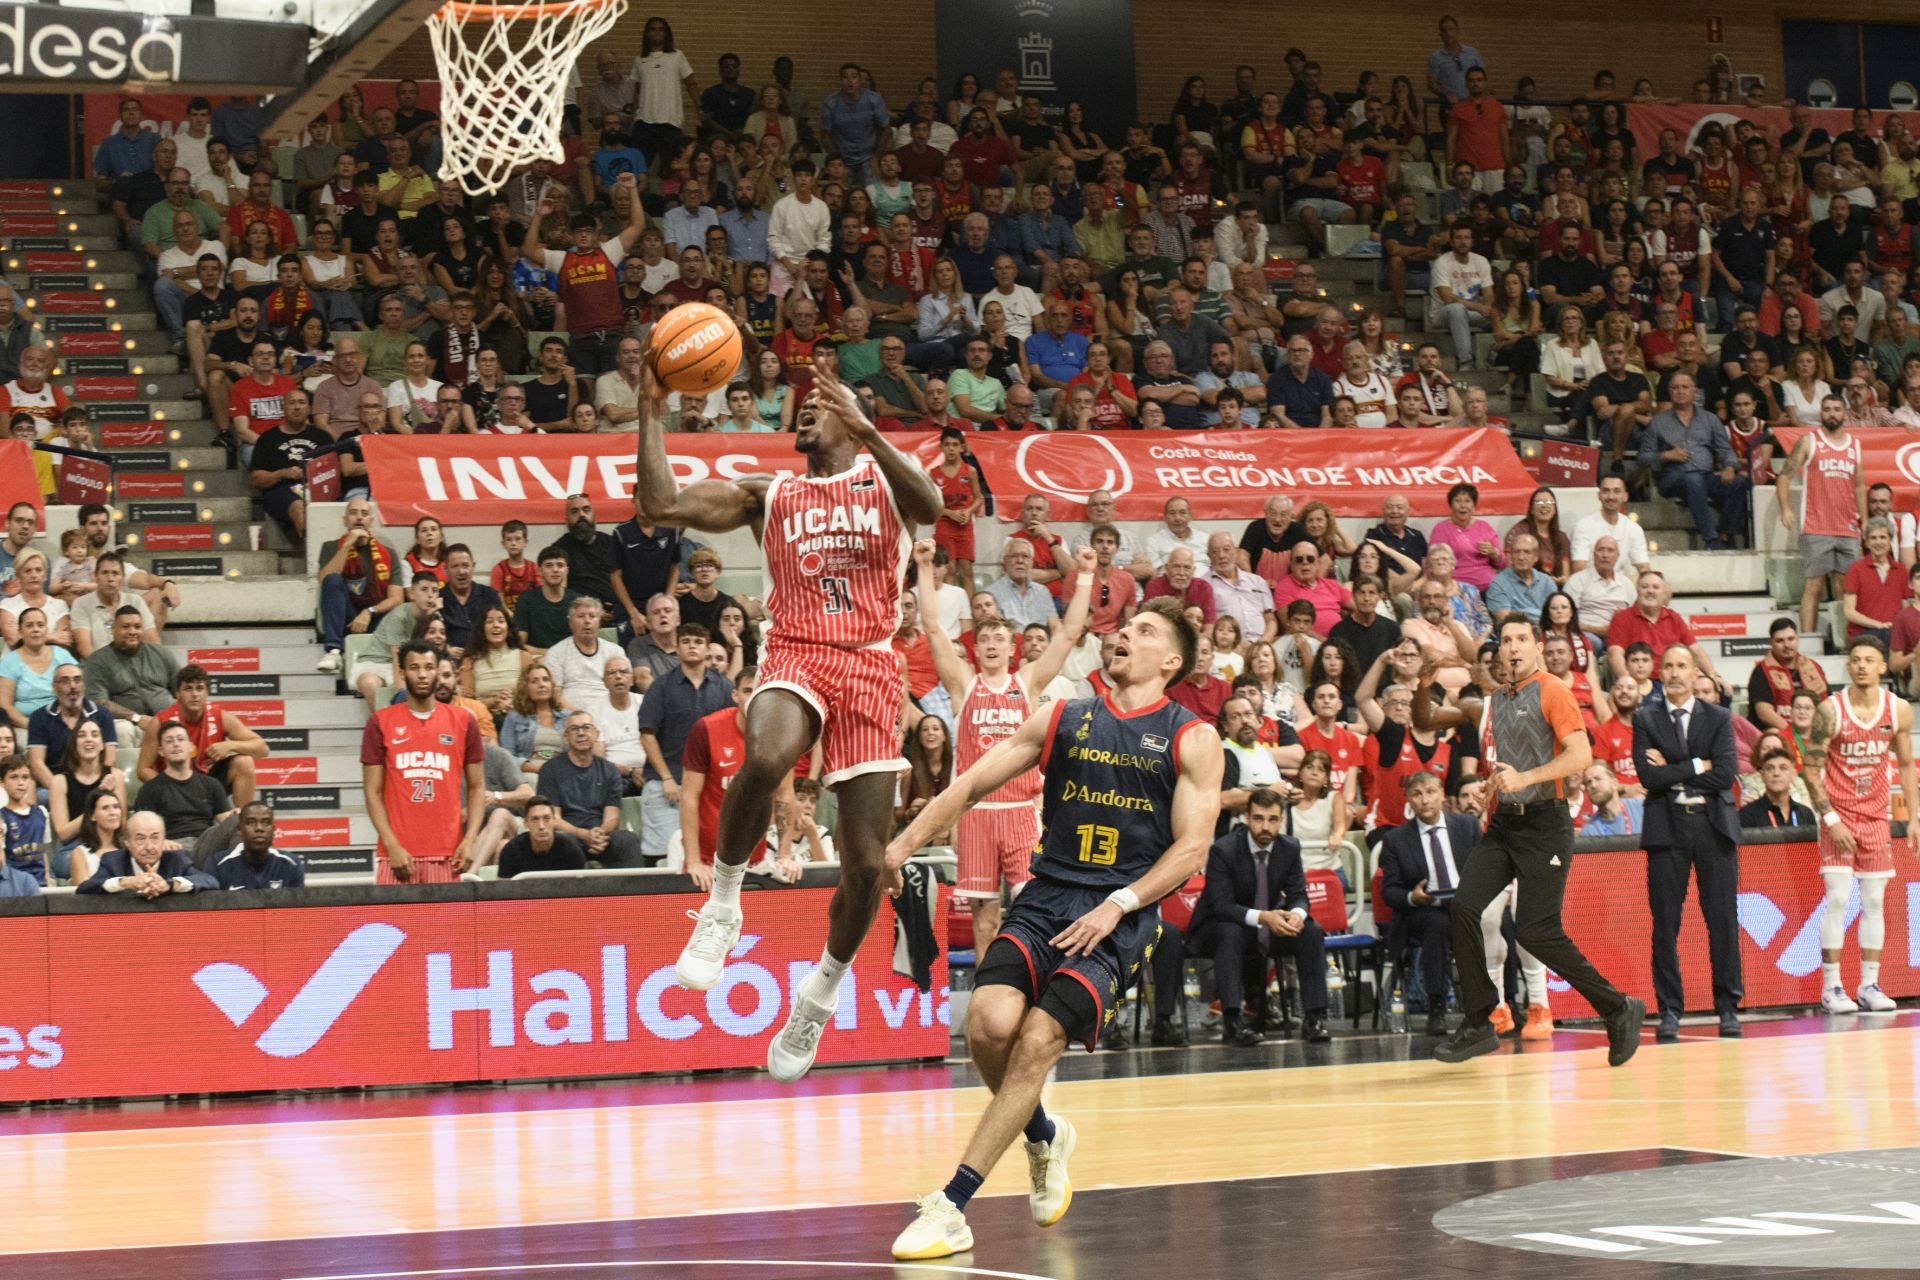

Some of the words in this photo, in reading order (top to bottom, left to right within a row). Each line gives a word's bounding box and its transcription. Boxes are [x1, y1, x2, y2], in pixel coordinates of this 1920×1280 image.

[667, 322, 725, 360] Wilson
[1149, 446, 1201, 461] Costa
[1203, 447, 1257, 463] Cálida
[1547, 456, 1590, 471] MÓDULO
[1155, 463, 1297, 488] REGIÓN
[1300, 466, 1352, 486] DE
[1359, 465, 1498, 487] MURCIA
[1819, 459, 1855, 475] UCAM
[66, 472, 104, 490] MÓDULO
[80, 489, 87, 498] 7
[783, 504, 881, 544] UCAM
[797, 535, 865, 557] MURCIA
[821, 577, 855, 615] 31
[972, 708, 1024, 725] UCAM
[1840, 740, 1889, 756] UCAM
[396, 751, 450, 771] UCAM
[402, 769, 444, 780] MURCIA
[411, 780, 435, 803] 24
[1077, 785, 1155, 812] Andorra
[1076, 823, 1120, 866] 13
[426, 934, 859, 1050] Halcón
